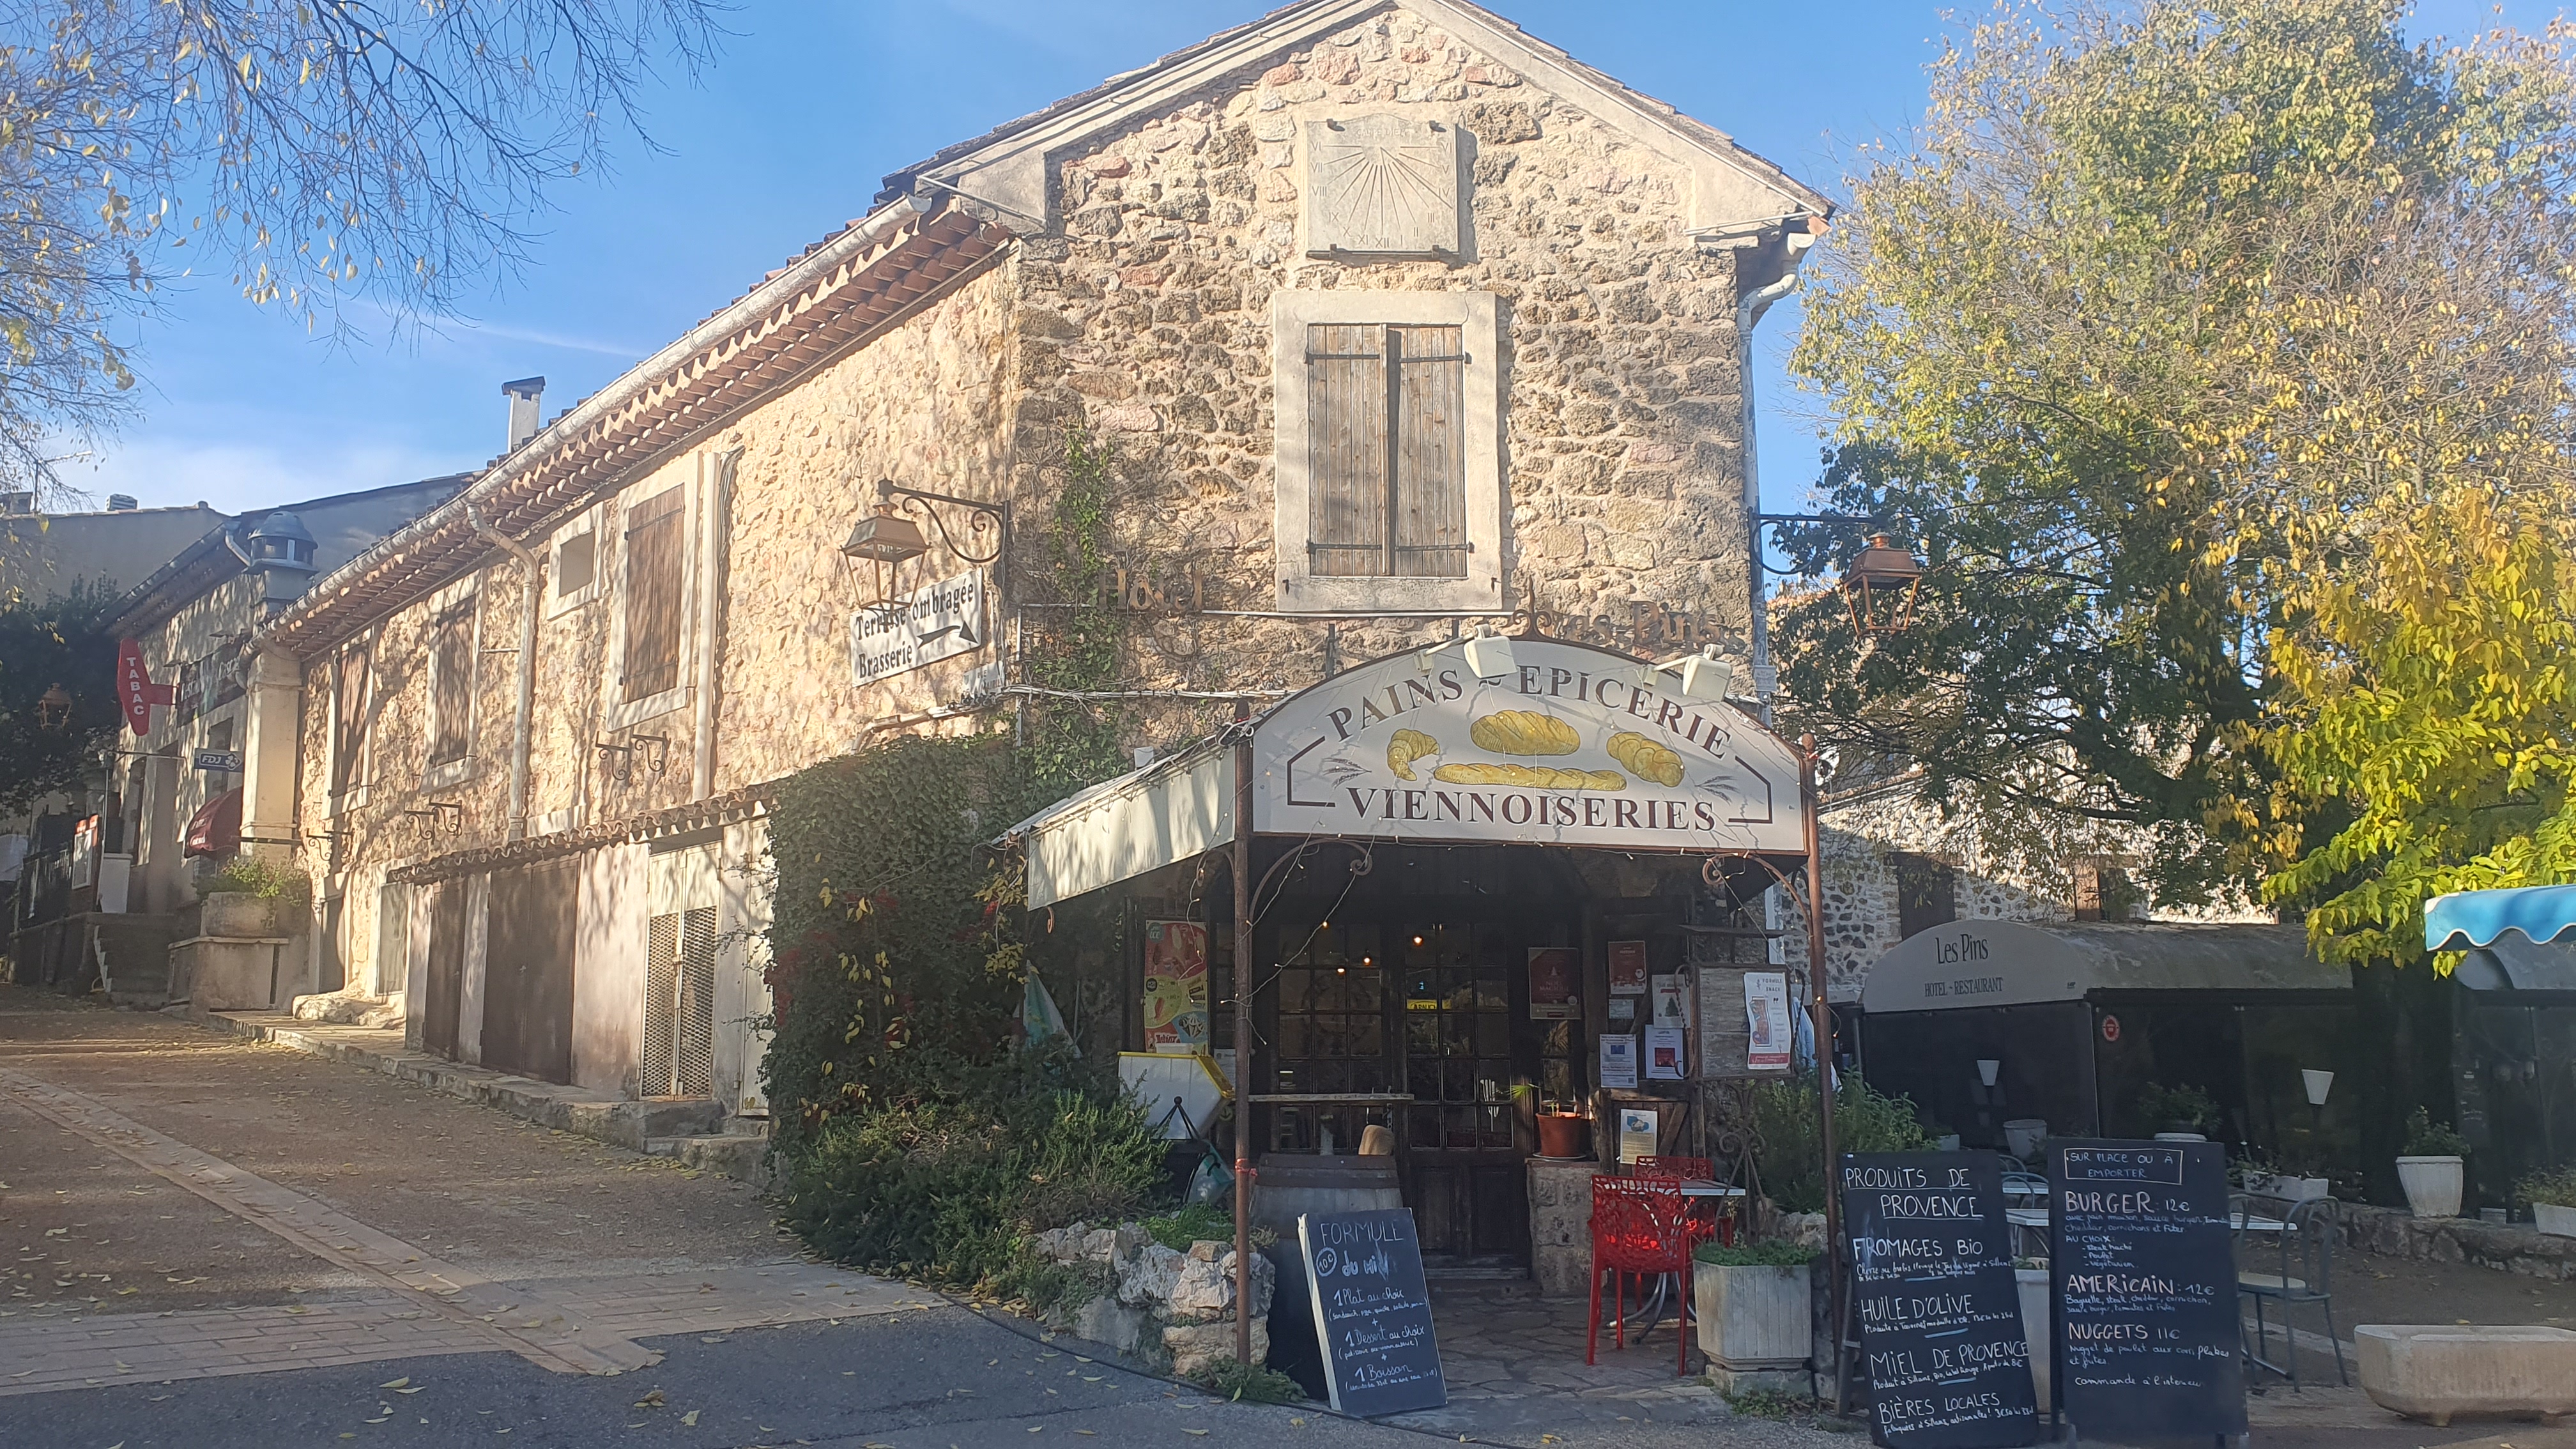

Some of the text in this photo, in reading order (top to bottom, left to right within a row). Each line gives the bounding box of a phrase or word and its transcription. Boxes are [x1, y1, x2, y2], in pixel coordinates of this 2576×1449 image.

[1312, 142, 1321, 151] VI
[1441, 143, 1452, 153] VI
[1310, 162, 1322, 172] VII
[1442, 165, 1449, 174] V
[1312, 186, 1327, 196] VIII
[1439, 187, 1450, 197] IV
[1329, 212, 1339, 222] IX
[1343, 227, 1351, 236] X
[1414, 227, 1418, 237] II
[1358, 234, 1368, 245] XI
[1376, 238, 1389, 247] XII
[912, 579, 974, 621] ombragée
[859, 640, 912, 678] Brasserie
[126, 657, 144, 716] TABAC
[1326, 664, 1731, 761] PAINS EPICERIE
[202, 755, 222, 764] FDJ
[1346, 786, 1716, 832] VIENNOISERIES
[1935, 933, 1989, 964] Les Pins
[1925, 977, 2004, 997] HOTEL RESTAURANT
[2070, 1152, 2091, 1162] SUR
[2138, 1155, 2153, 1163] OU
[1949, 1169, 1970, 1187] DE
[2088, 1169, 2147, 1178] EMPORTER
[1880, 1194, 1984, 1217] PROVENCE
[2165, 1199, 2190, 1212] 12€
[2087, 1215, 2103, 1223] pain
[1320, 1220, 1405, 1246] FORMULE
[1853, 1236, 1943, 1260] FROMAGES
[2184, 1284, 2215, 1296] 12€
[1333, 1287, 1405, 1307] 1 Plat au choix
[1864, 1322, 1892, 1334] Produite
[1894, 1322, 1899, 1331] à
[2068, 1322, 2181, 1340] NUGGETS 11€
[1345, 1331, 1354, 1347] 1
[1354, 1322, 1387, 1345] Dessert
[1402, 1324, 1425, 1338] choix
[1933, 1348, 1952, 1369] DE
[1958, 1341, 2029, 1366] PROVENCE
[2069, 1343, 2099, 1356] Nugget
[2104, 1344, 2113, 1353] de
[2118, 1343, 2147, 1355] poulet
[2069, 1356, 2080, 1365] et
[1355, 1367, 1365, 1382] 1
[1367, 1364, 1412, 1381] Boisson
[1873, 1377, 1899, 1390] Produit
[1901, 1377, 1906, 1385] à
[2011, 1358, 2023, 1368] 8€
[2143, 1377, 2150, 1385] à
[1945, 1392, 2000, 1412] LOCALES
[1919, 1420, 1924, 1429] à
